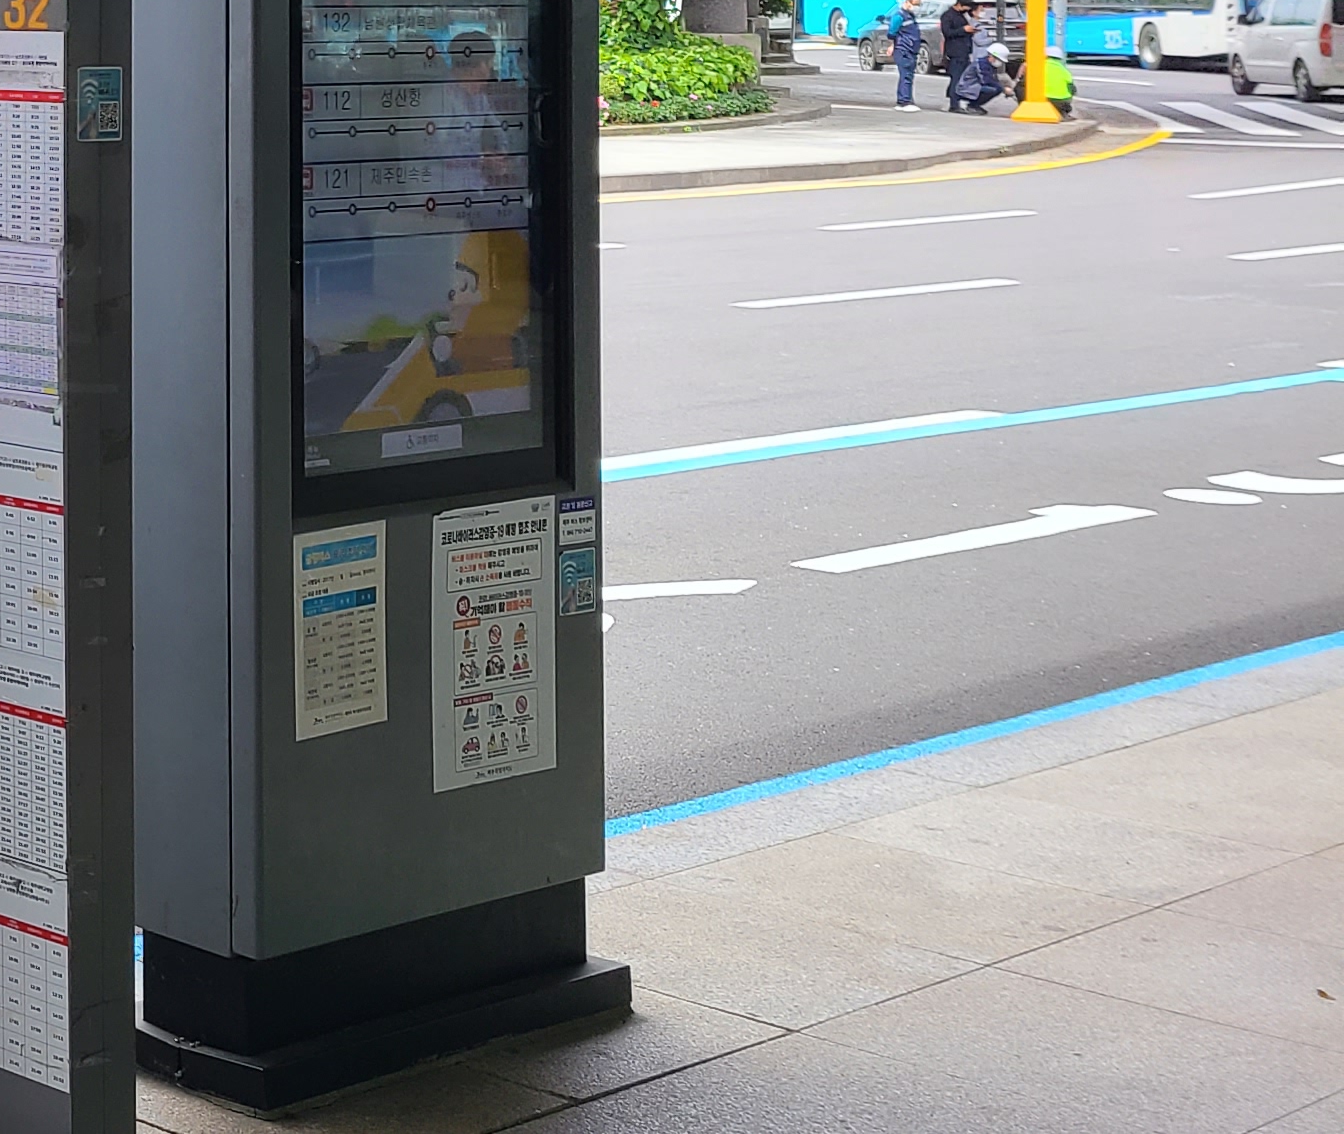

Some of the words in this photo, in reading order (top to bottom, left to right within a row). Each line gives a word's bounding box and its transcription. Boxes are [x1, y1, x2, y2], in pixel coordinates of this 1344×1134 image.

[323, 12, 351, 32] 132
[322, 90, 352, 111] 112
[380, 88, 422, 109] 성산항
[323, 168, 349, 189] 121
[370, 166, 433, 184] 제주민속촌
